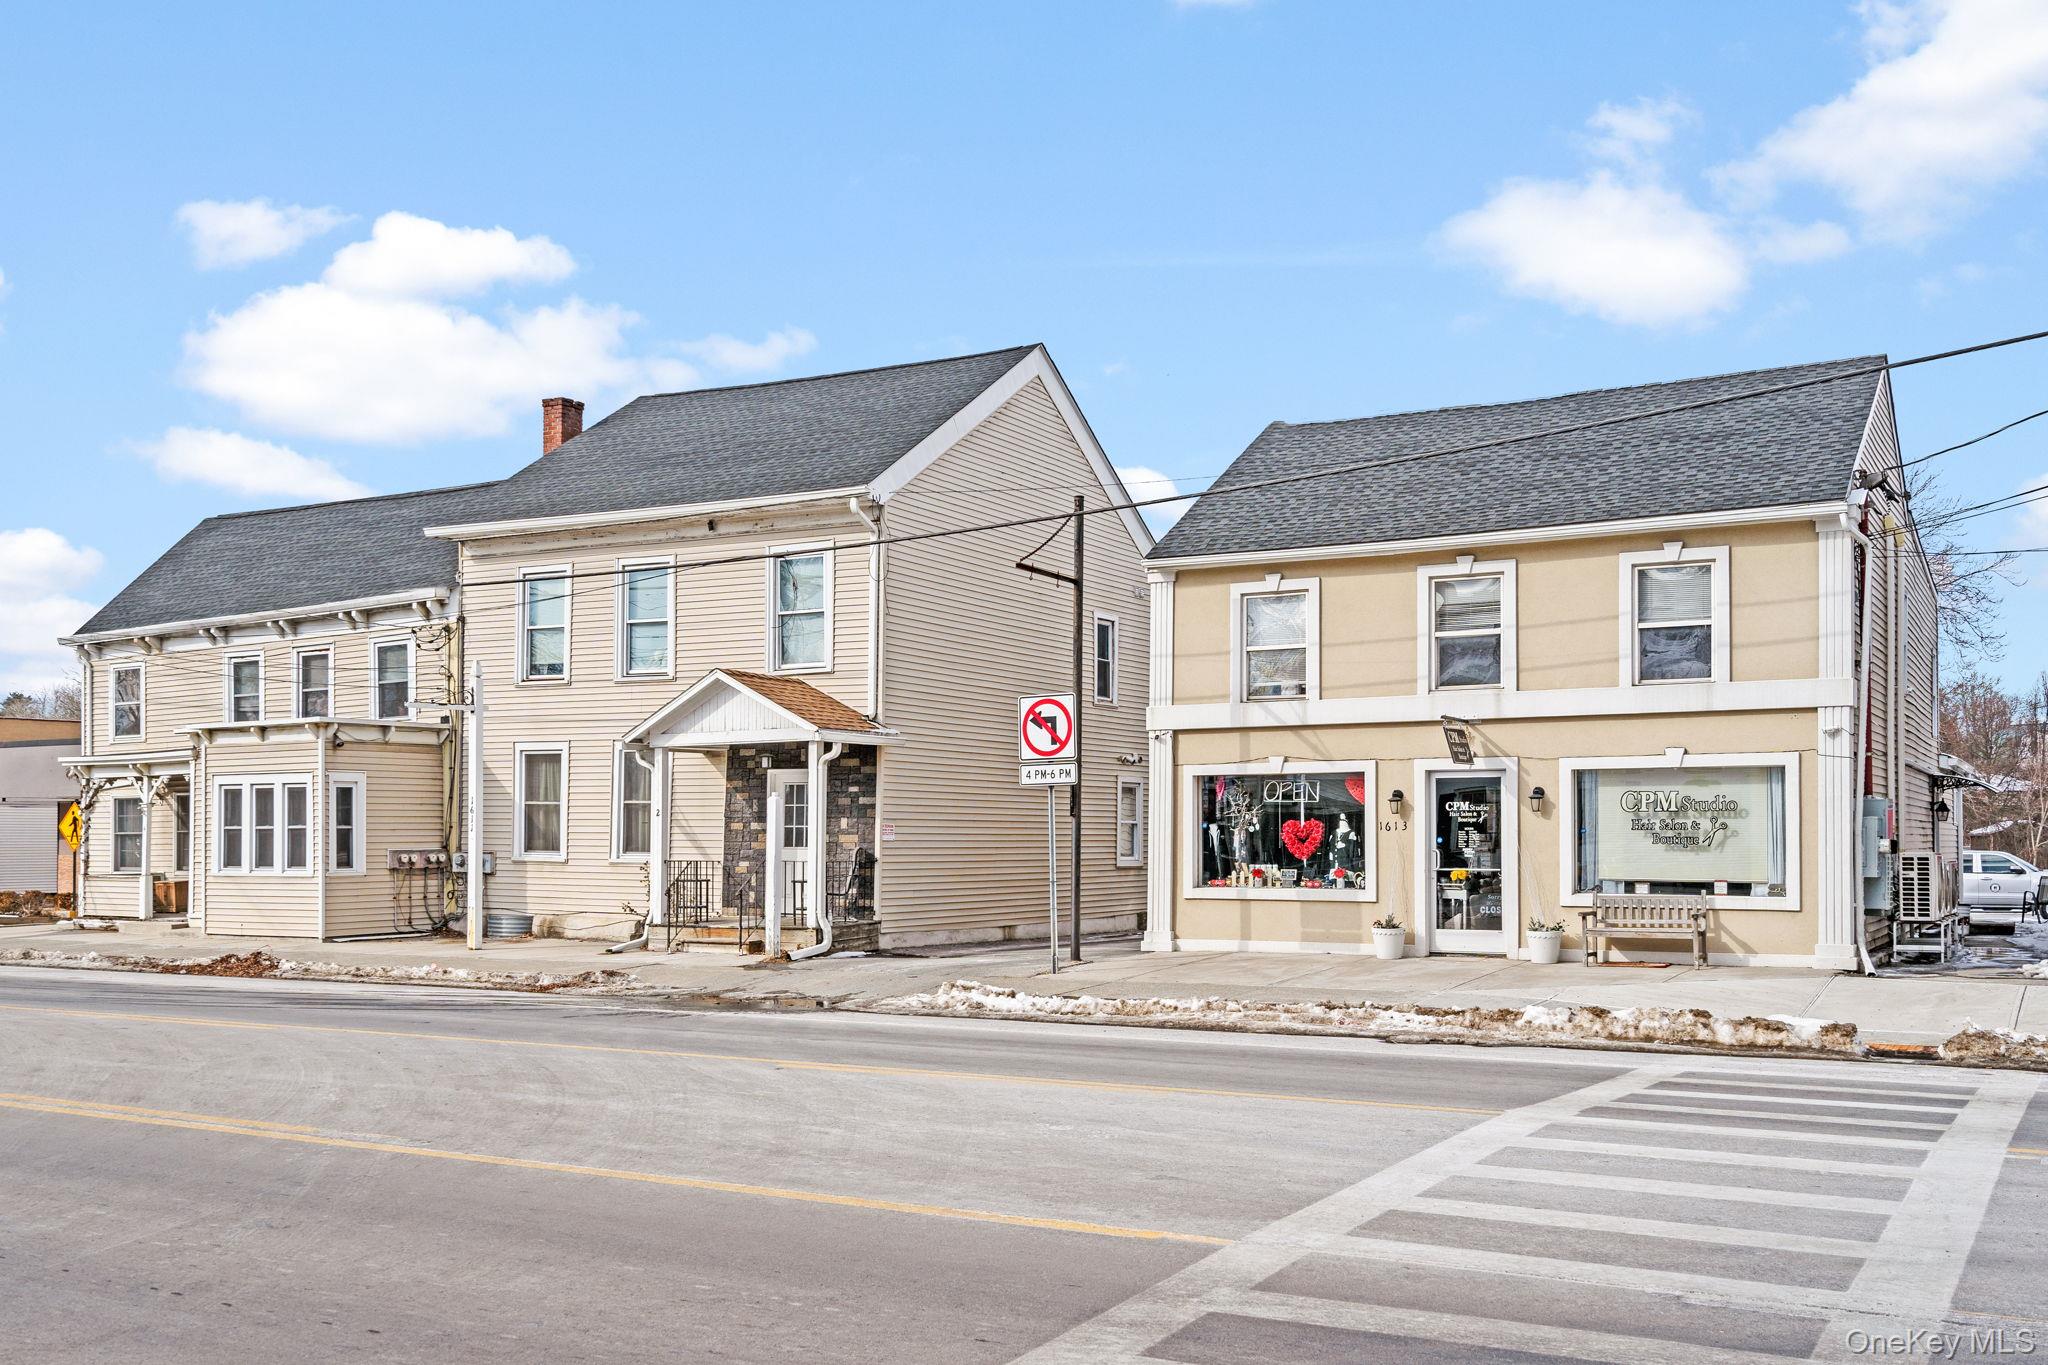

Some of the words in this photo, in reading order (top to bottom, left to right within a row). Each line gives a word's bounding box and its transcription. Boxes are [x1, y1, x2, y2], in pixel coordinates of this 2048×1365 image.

[1026, 770, 1031, 779] 4
[1060, 768, 1071, 778] PM
[1264, 780, 1319, 802] OPEN
[1445, 801, 1470, 811] CPM
[1620, 790, 1679, 812] CPM
[1681, 795, 1738, 811] Studio
[656, 808, 660, 816] 2
[1380, 821, 1407, 831] 1613
[1631, 819, 1656, 830] Hair
[1659, 818, 1688, 830] Salon
[1690, 820, 1700, 830] &
[1652, 833, 1699, 848] Boutique
